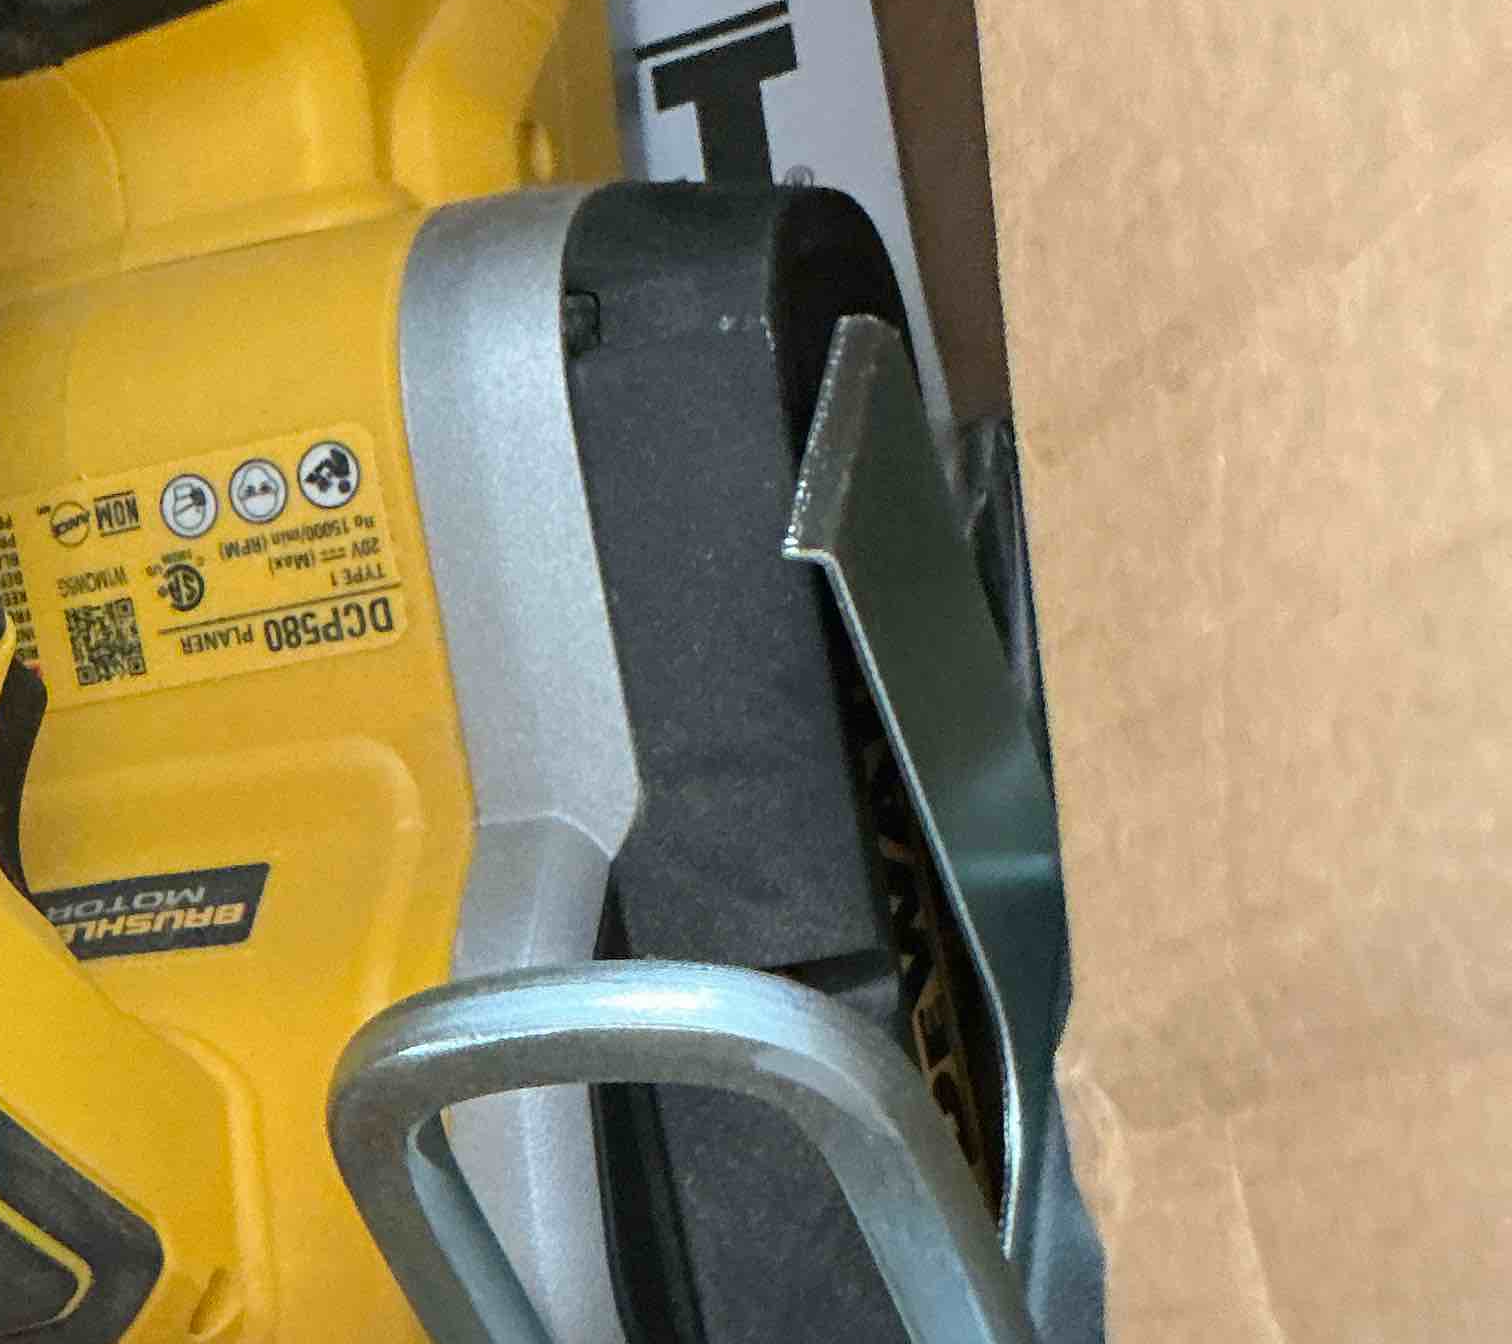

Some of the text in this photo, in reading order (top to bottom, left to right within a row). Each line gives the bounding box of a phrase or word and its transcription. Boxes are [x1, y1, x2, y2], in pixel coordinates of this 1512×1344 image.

[219, 536, 268, 560] (RPM)
[329, 562, 385, 586] TYPE 1
[180, 596, 393, 655] DCP580 PLANER
[46, 886, 207, 923] MOTOR
